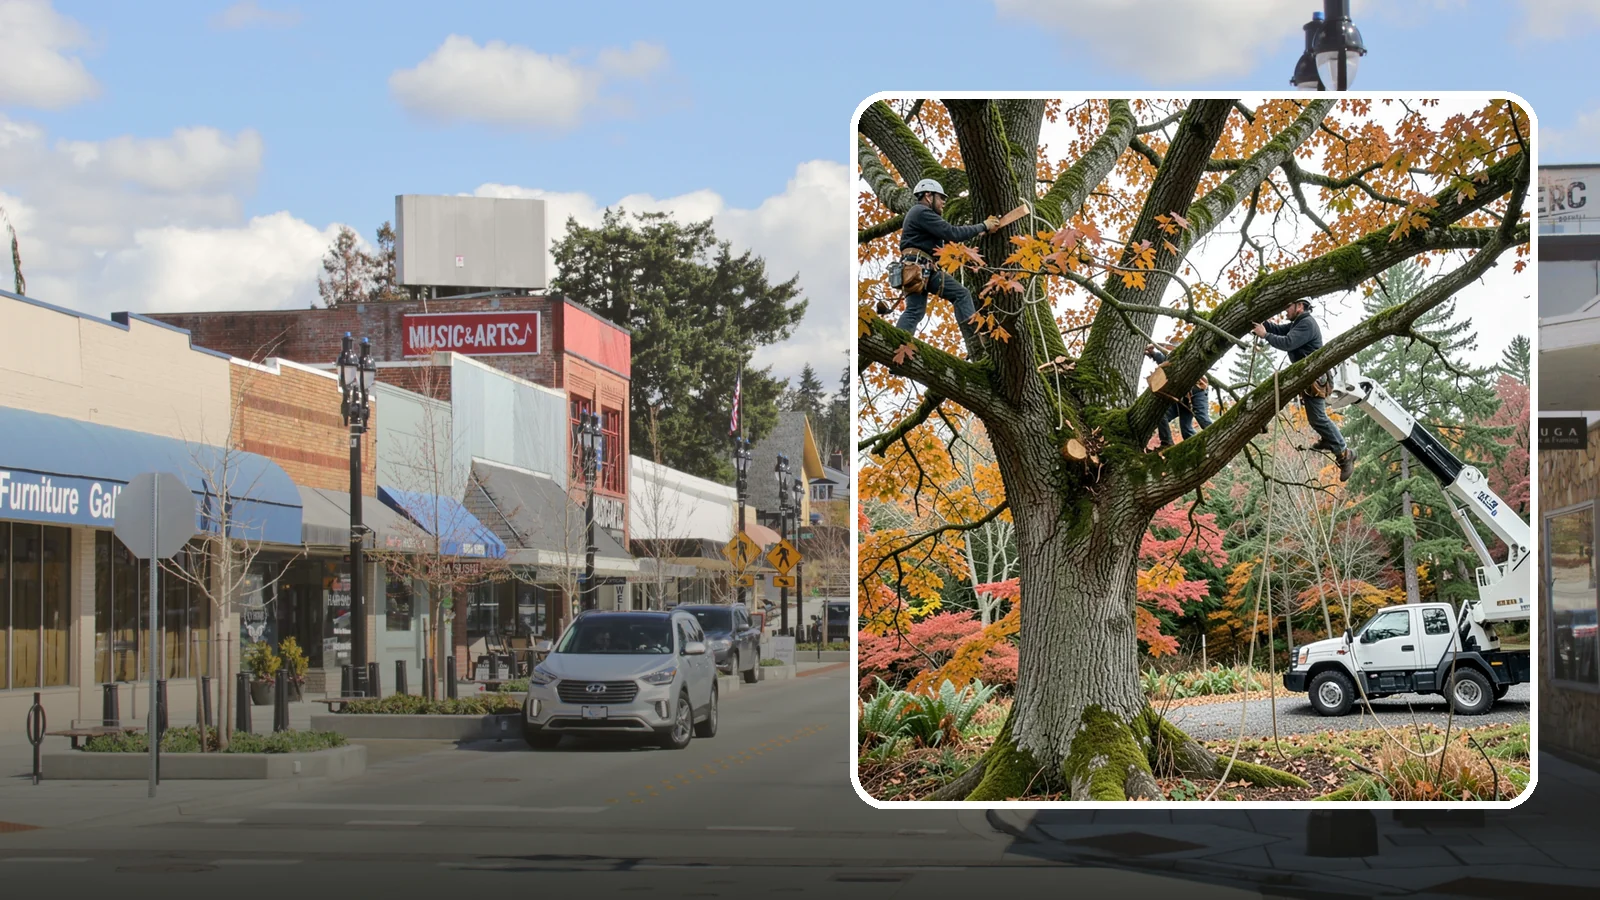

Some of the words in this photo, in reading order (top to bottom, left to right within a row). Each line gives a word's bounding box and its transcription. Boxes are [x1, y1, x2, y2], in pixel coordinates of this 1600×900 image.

[0, 472, 79, 515] Furniture
[89, 482, 121, 519] Gal
[453, 563, 479, 574] SUSHI
